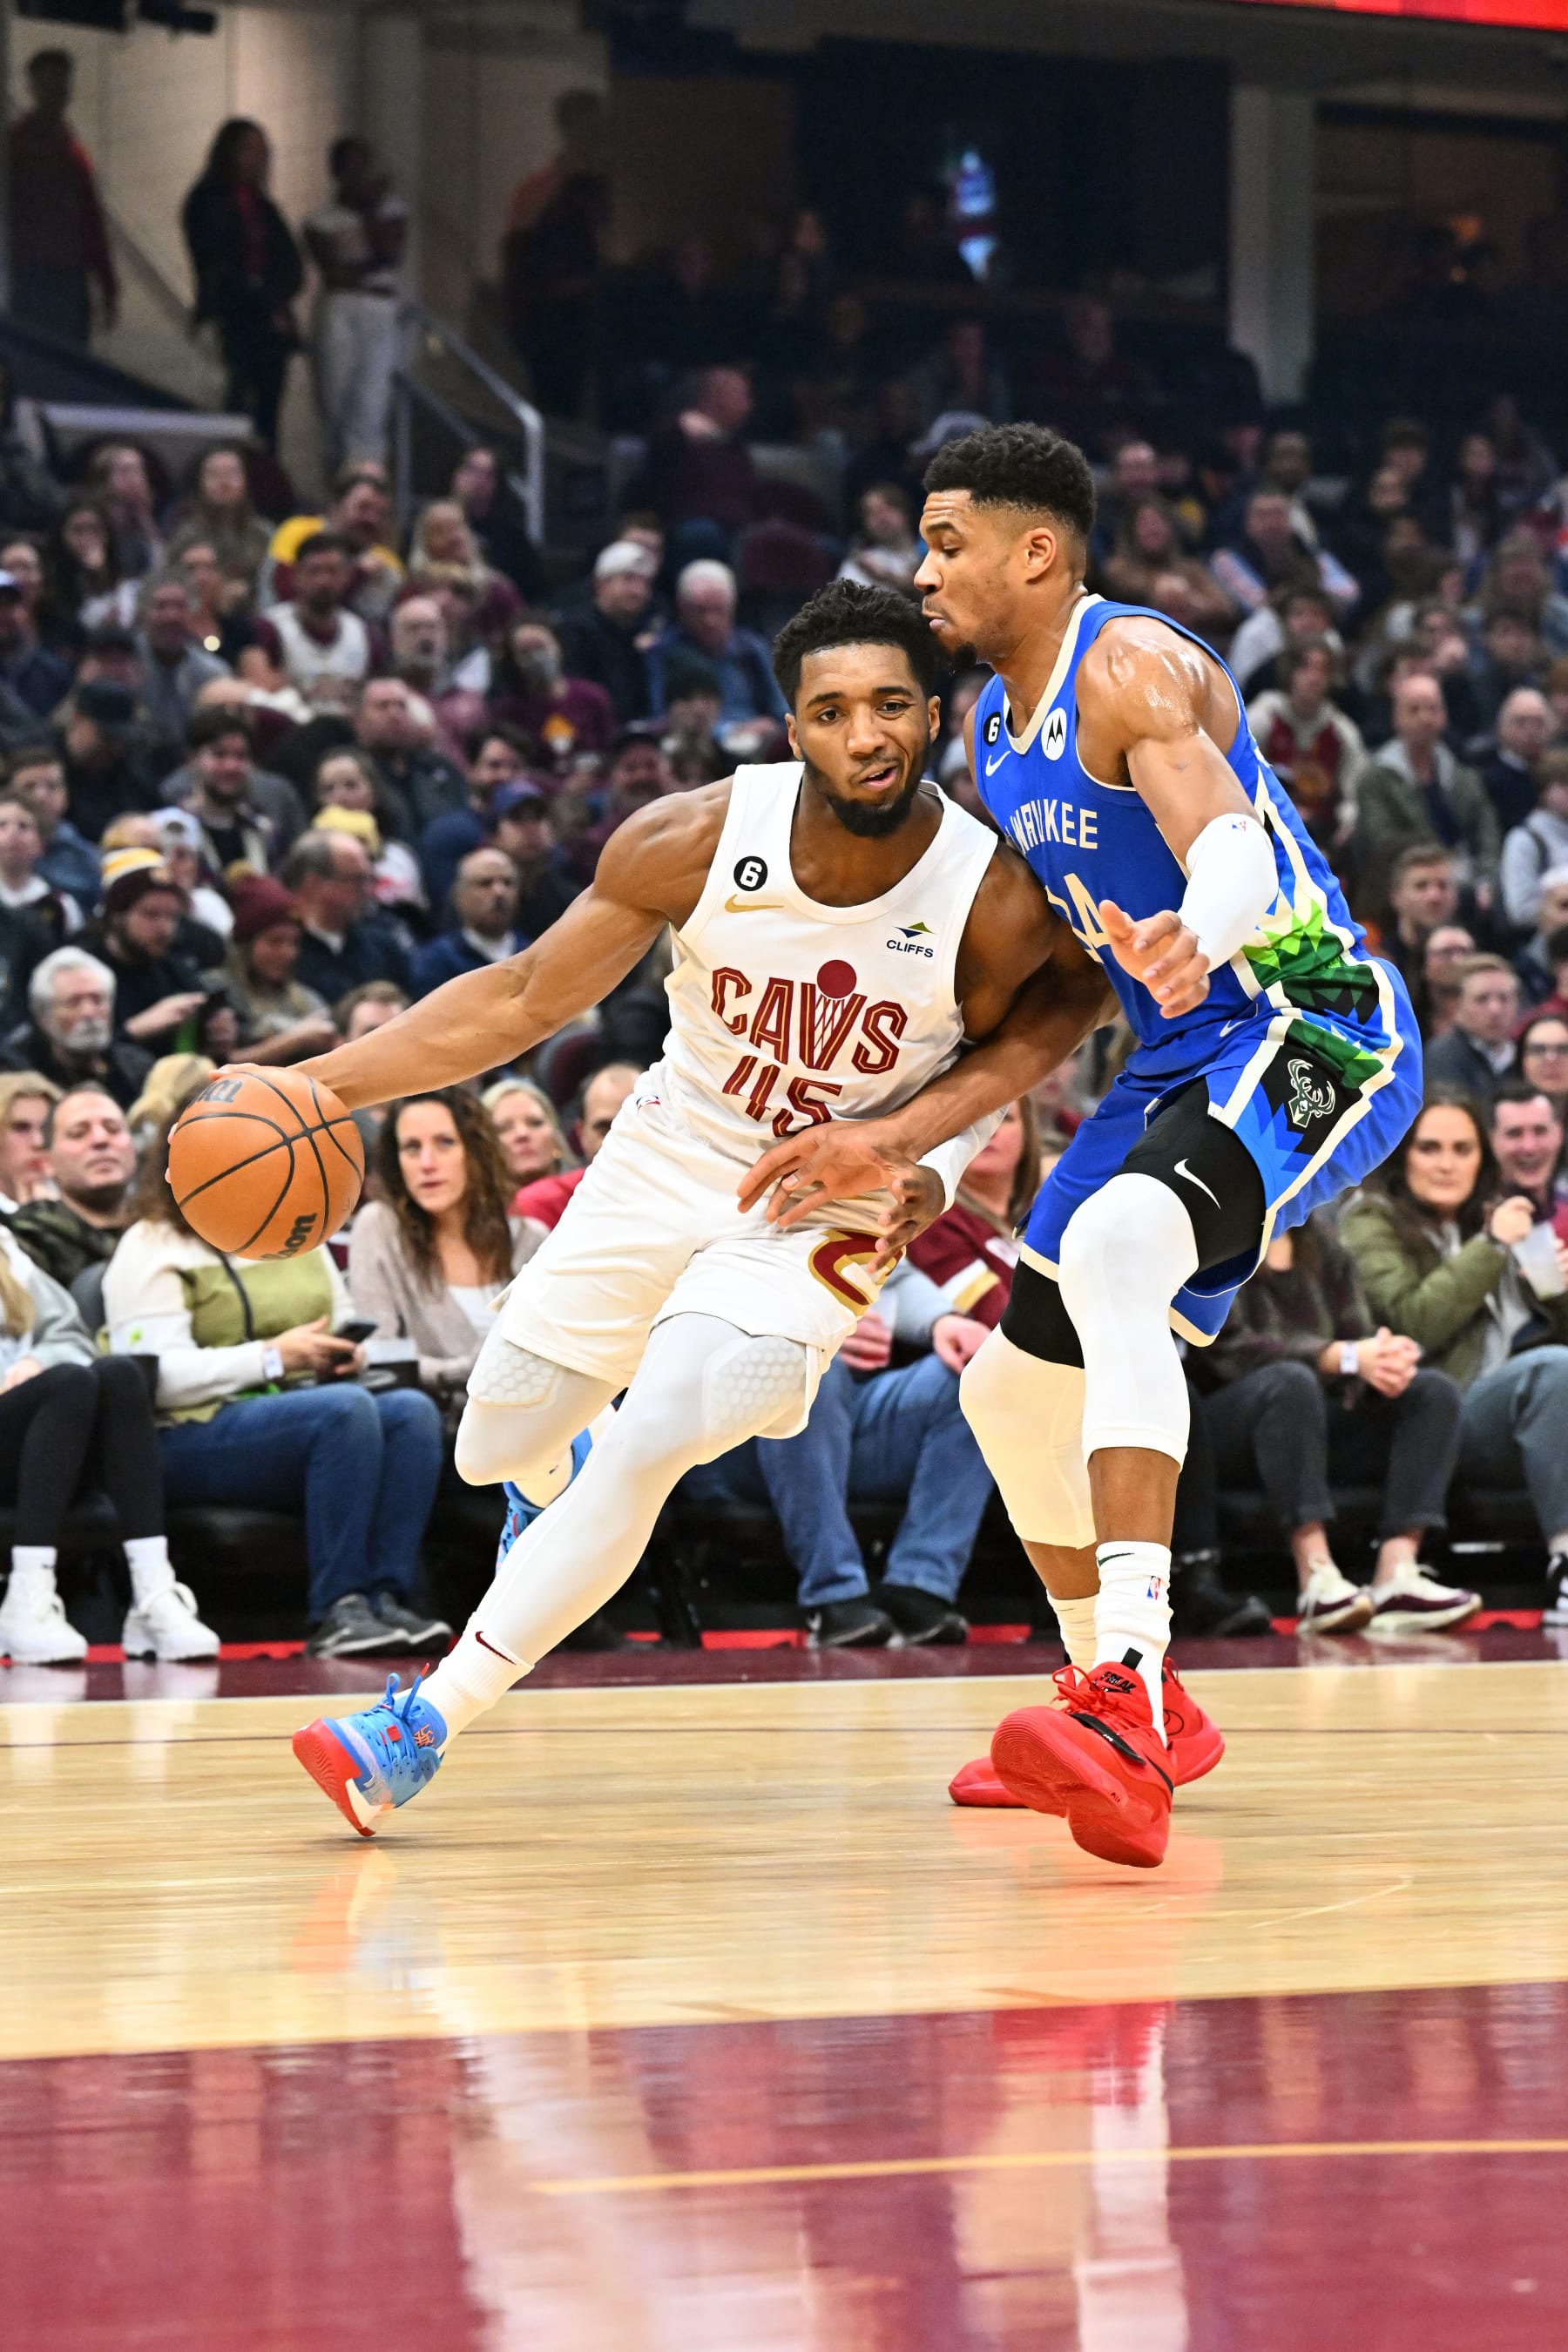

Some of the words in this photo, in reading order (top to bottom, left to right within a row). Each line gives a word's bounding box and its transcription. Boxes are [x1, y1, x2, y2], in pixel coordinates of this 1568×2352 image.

[988, 716, 1001, 743] 6
[1005, 798, 1098, 854] WAUKEE
[740, 861, 763, 888] 6
[886, 939, 934, 958] CLIFFS
[711, 966, 909, 1075] CAVS
[721, 1055, 843, 1138] 45
